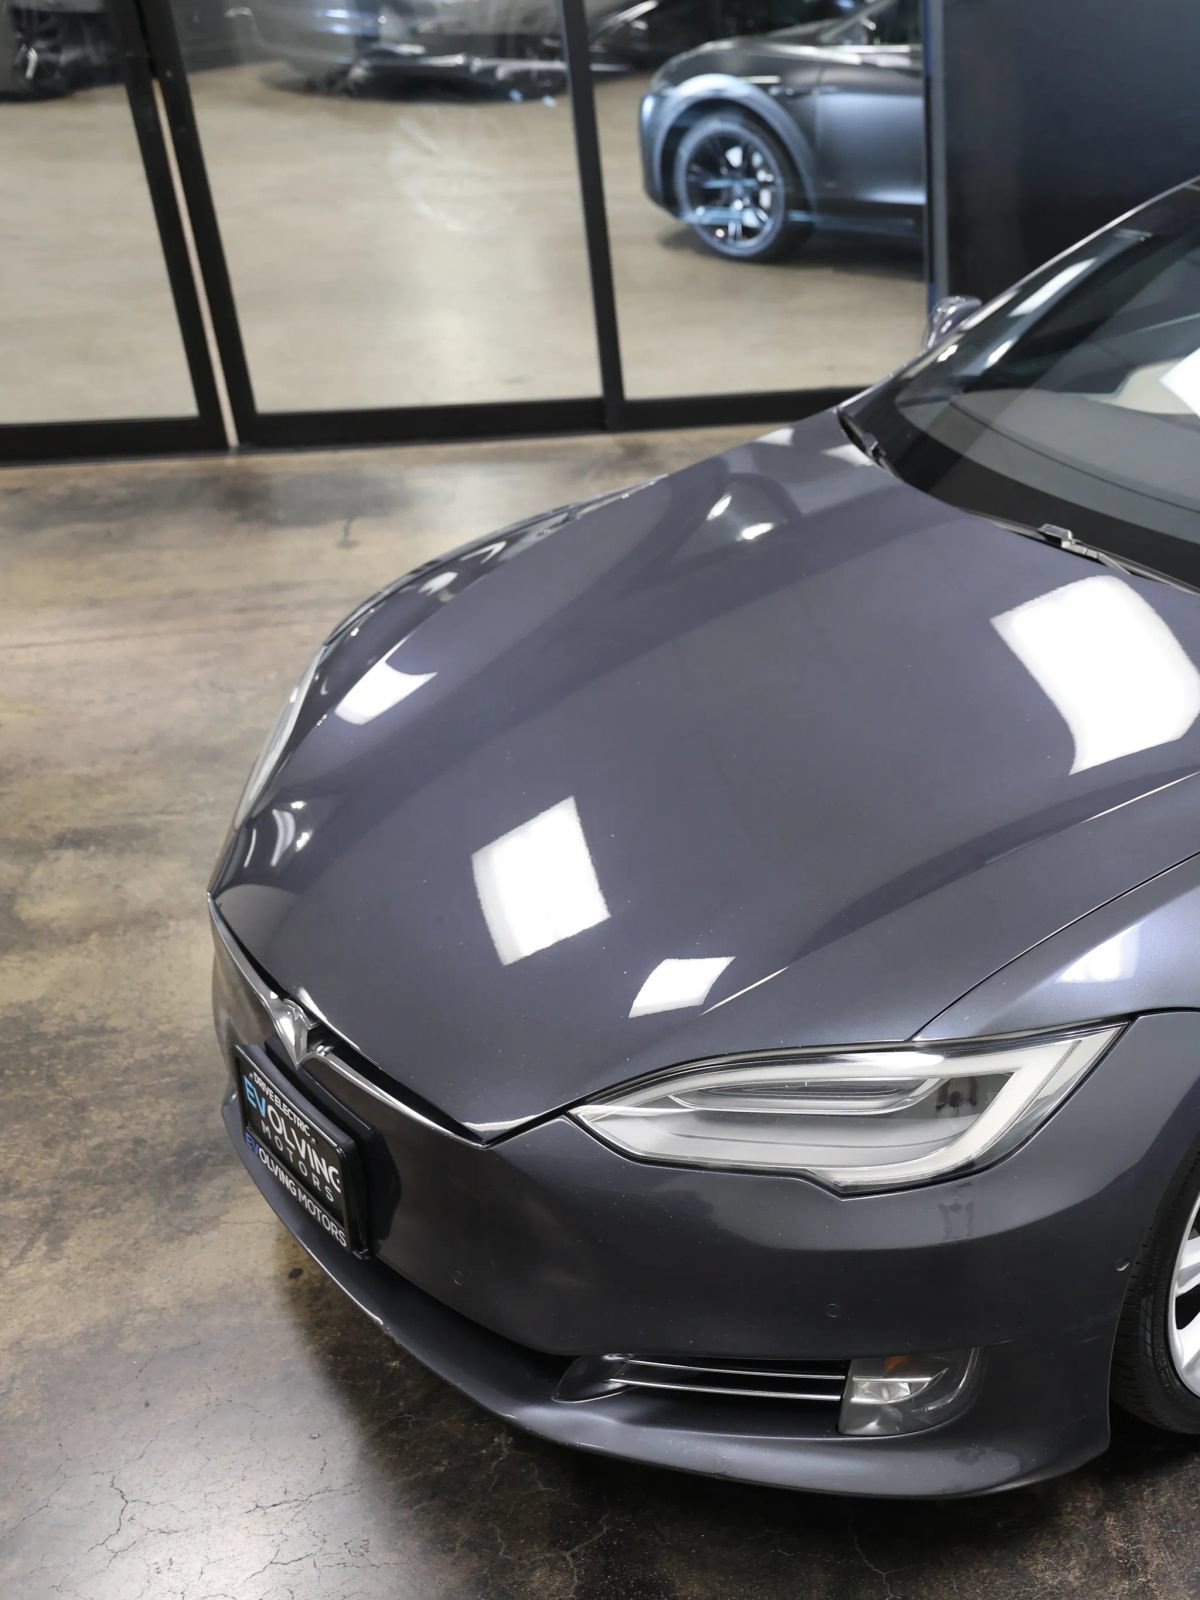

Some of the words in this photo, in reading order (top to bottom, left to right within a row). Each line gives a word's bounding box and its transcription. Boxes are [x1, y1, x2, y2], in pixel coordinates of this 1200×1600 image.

[252, 1071, 274, 1102] DRIVE
[274, 1094, 310, 1136] ELECTRIC
[245, 1132, 297, 1197] EVOLVING
[297, 1187, 347, 1247] MOTORS
[260, 1119, 334, 1202] MOTORS
